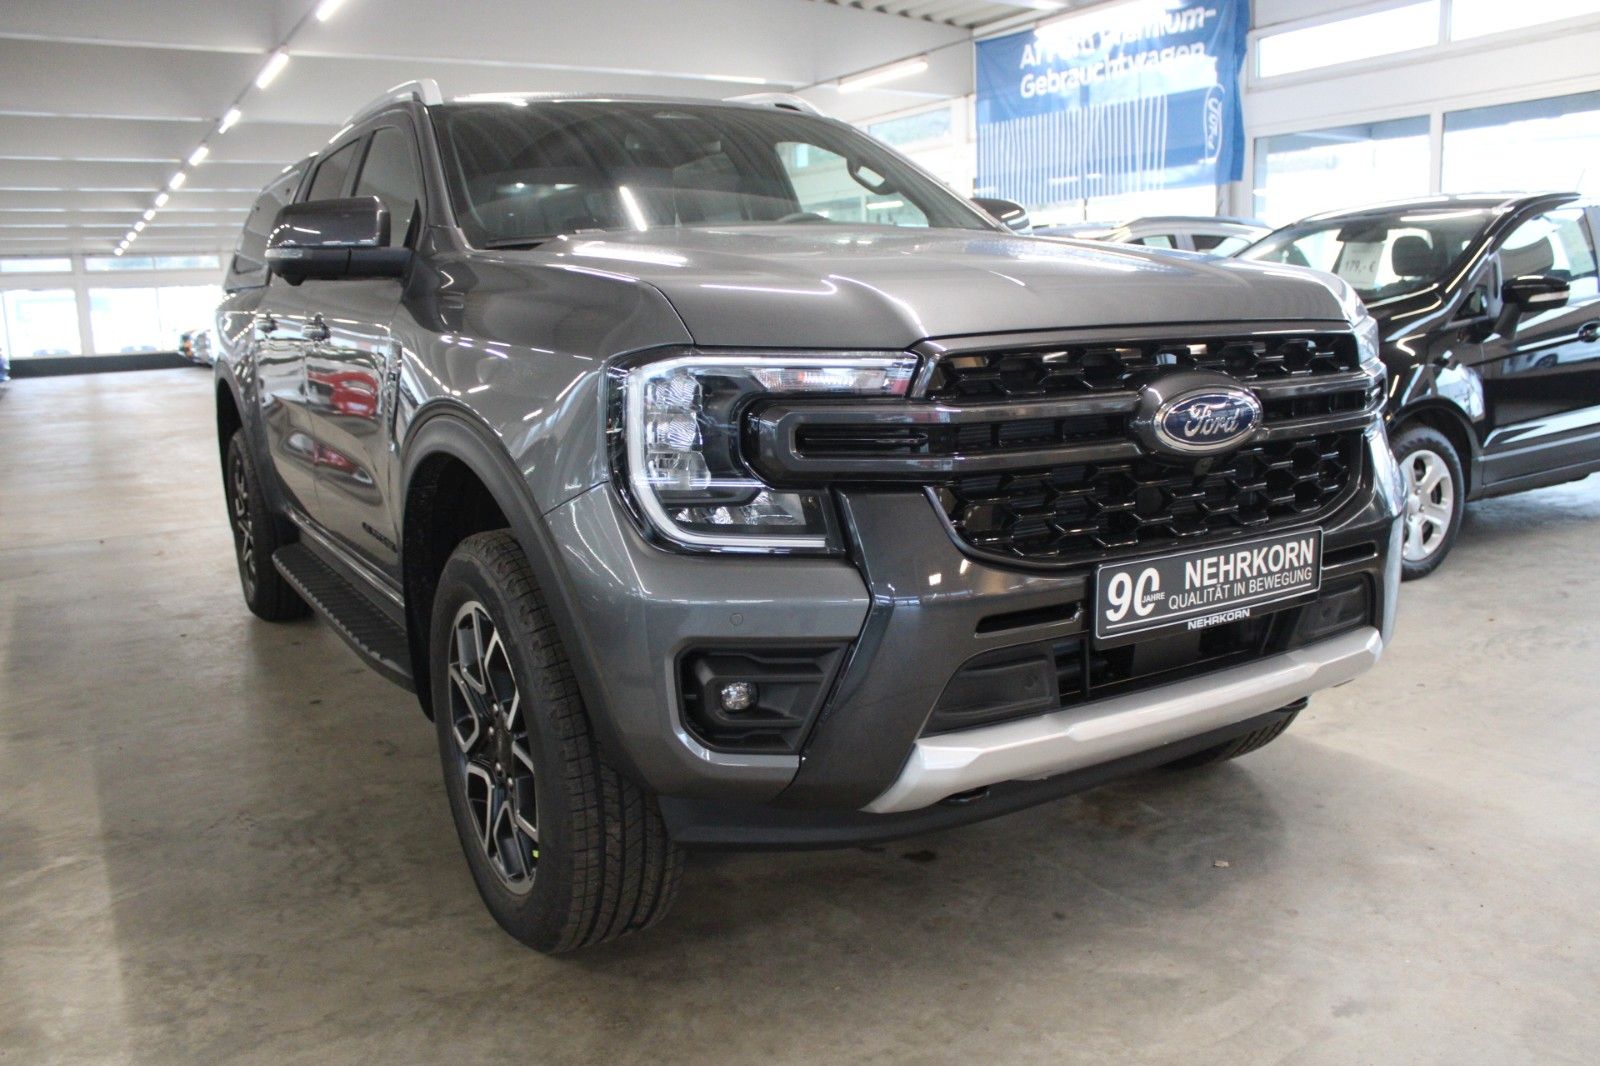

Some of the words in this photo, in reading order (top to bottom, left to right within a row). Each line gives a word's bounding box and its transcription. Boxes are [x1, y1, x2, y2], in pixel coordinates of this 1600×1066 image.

[1020, 42, 1205, 99] Gebrauchtwagen
[1184, 402, 1240, 437] Ford
[1185, 538, 1314, 589] NEHRKORN
[1105, 568, 1160, 621] 90
[1142, 591, 1165, 604] JAHRE
[1168, 583, 1231, 610] QUALITÄT
[1233, 582, 1246, 597] IN
[1249, 567, 1312, 593] BEWEGUNG
[1187, 609, 1250, 630] NEHRKORN
